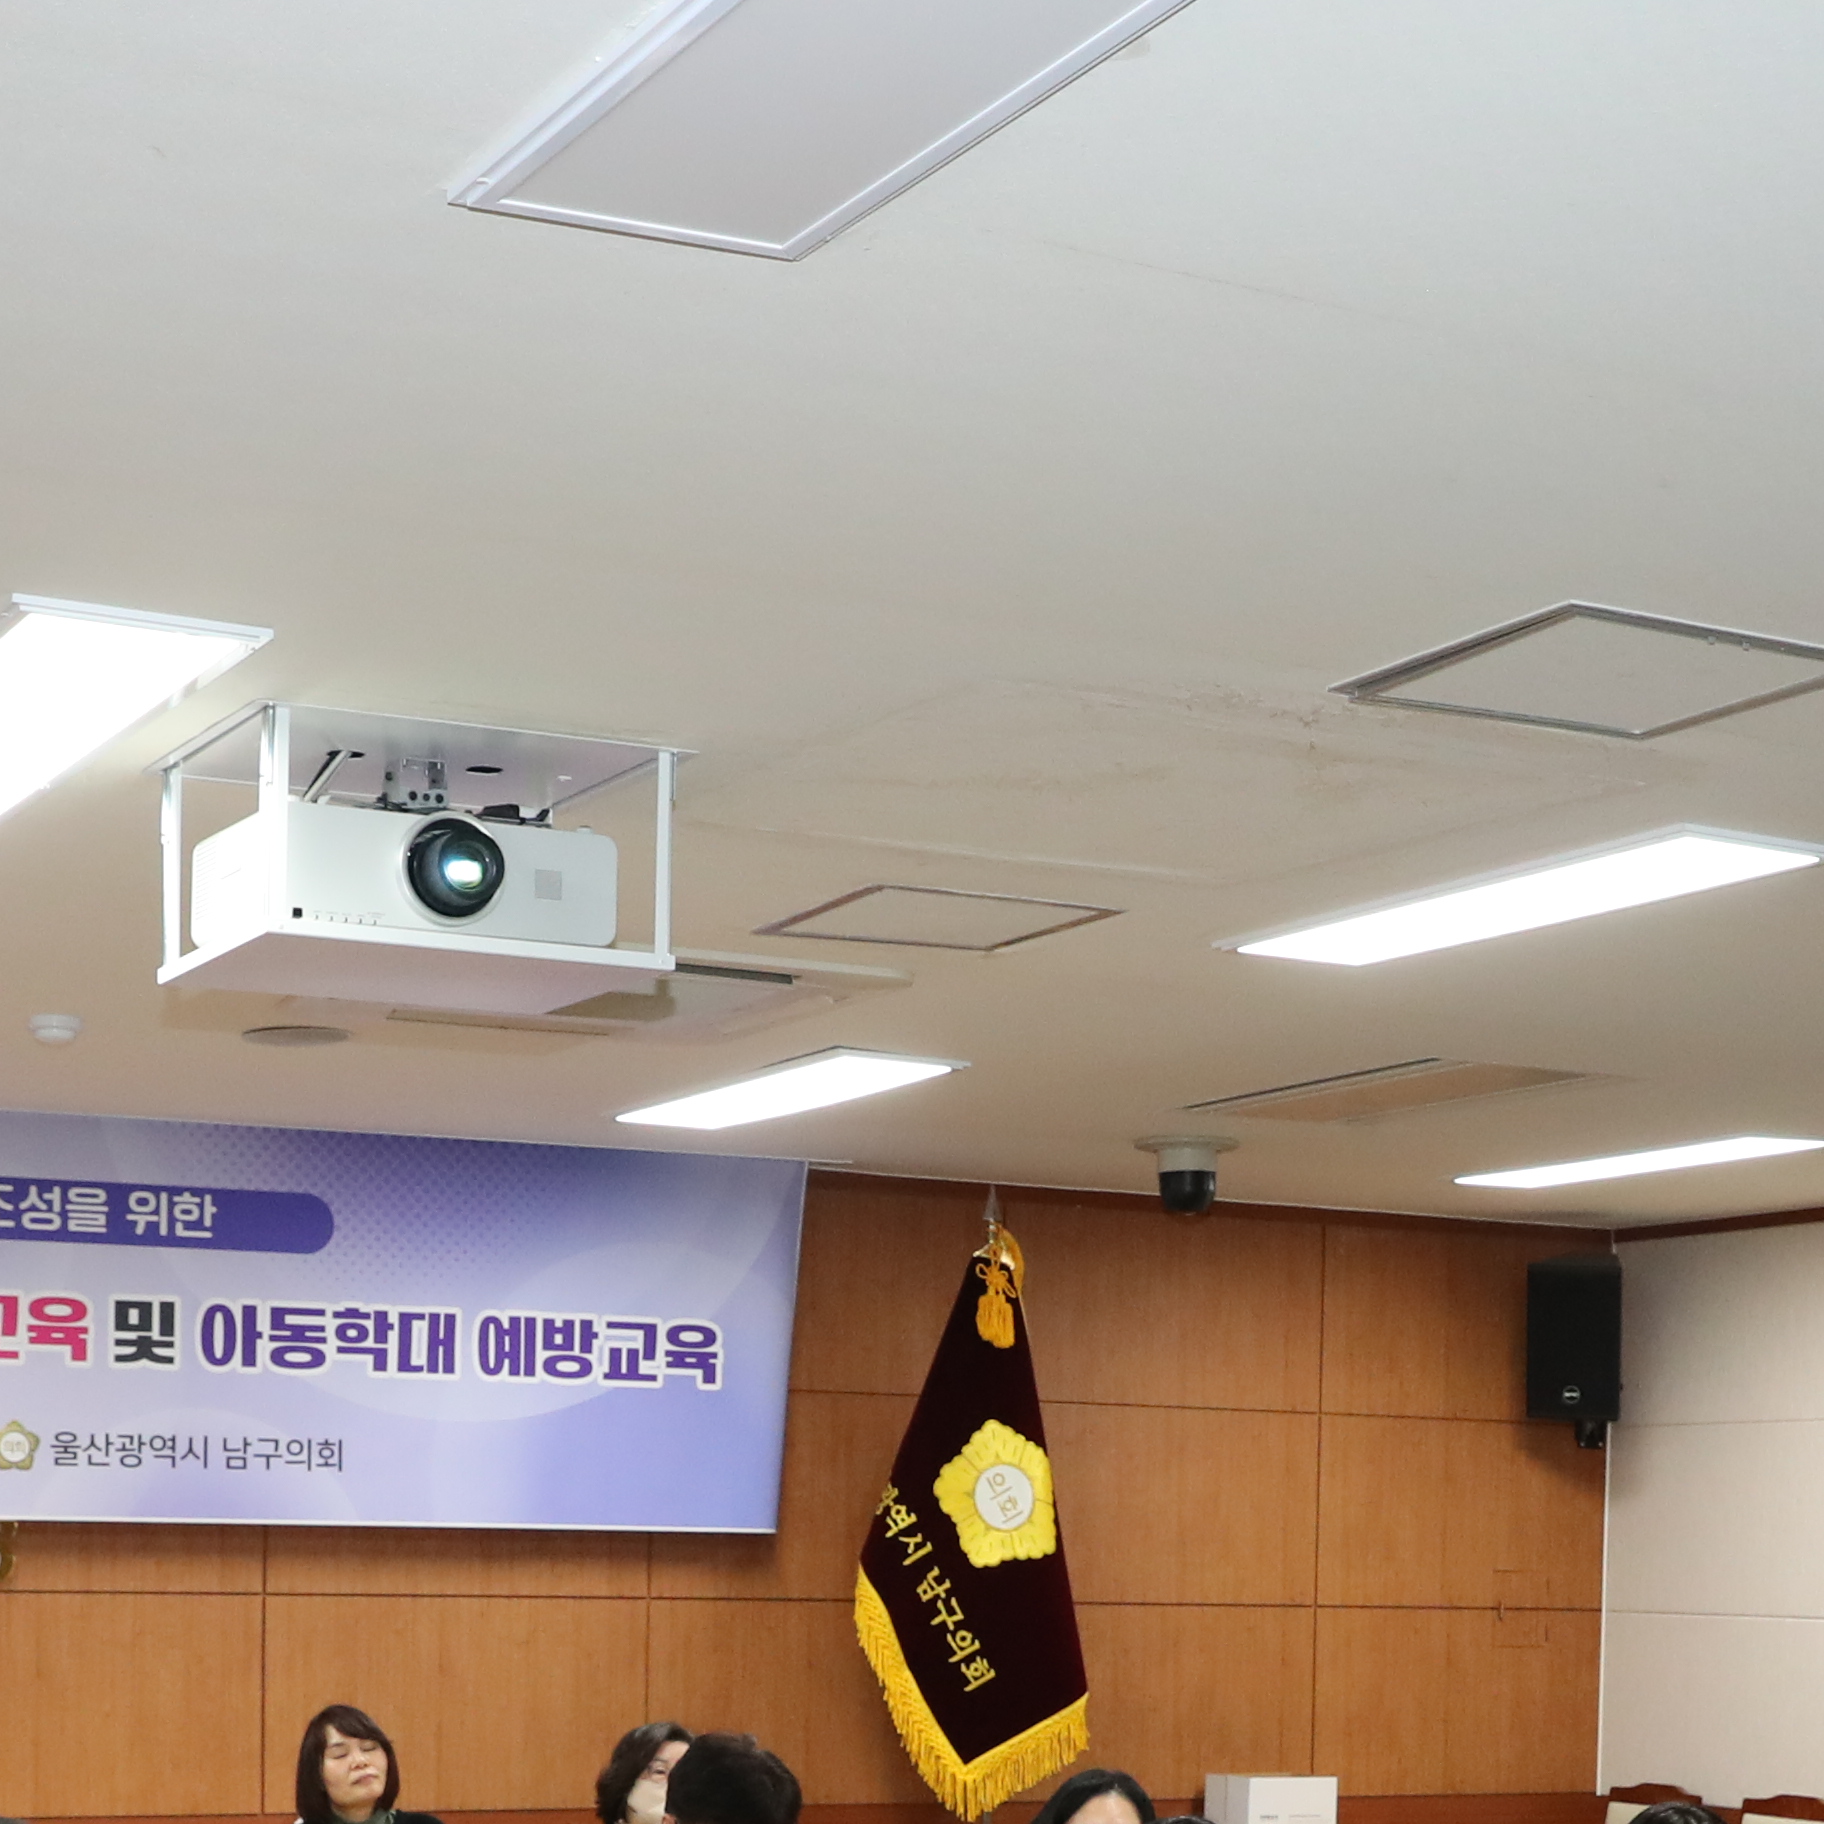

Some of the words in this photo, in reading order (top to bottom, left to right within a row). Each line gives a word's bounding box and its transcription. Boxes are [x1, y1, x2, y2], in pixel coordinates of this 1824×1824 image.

[125, 1191, 218, 1240] 위한
[113, 1299, 176, 1367] 및
[199, 1302, 458, 1377] 아동학대
[476, 1312, 723, 1387] 예방교육
[48, 1431, 210, 1471] 울산광역시
[221, 1435, 345, 1474] 남구의회
[984, 1470, 1025, 1525] 의회
[915, 1565, 997, 1694] 남구의회
